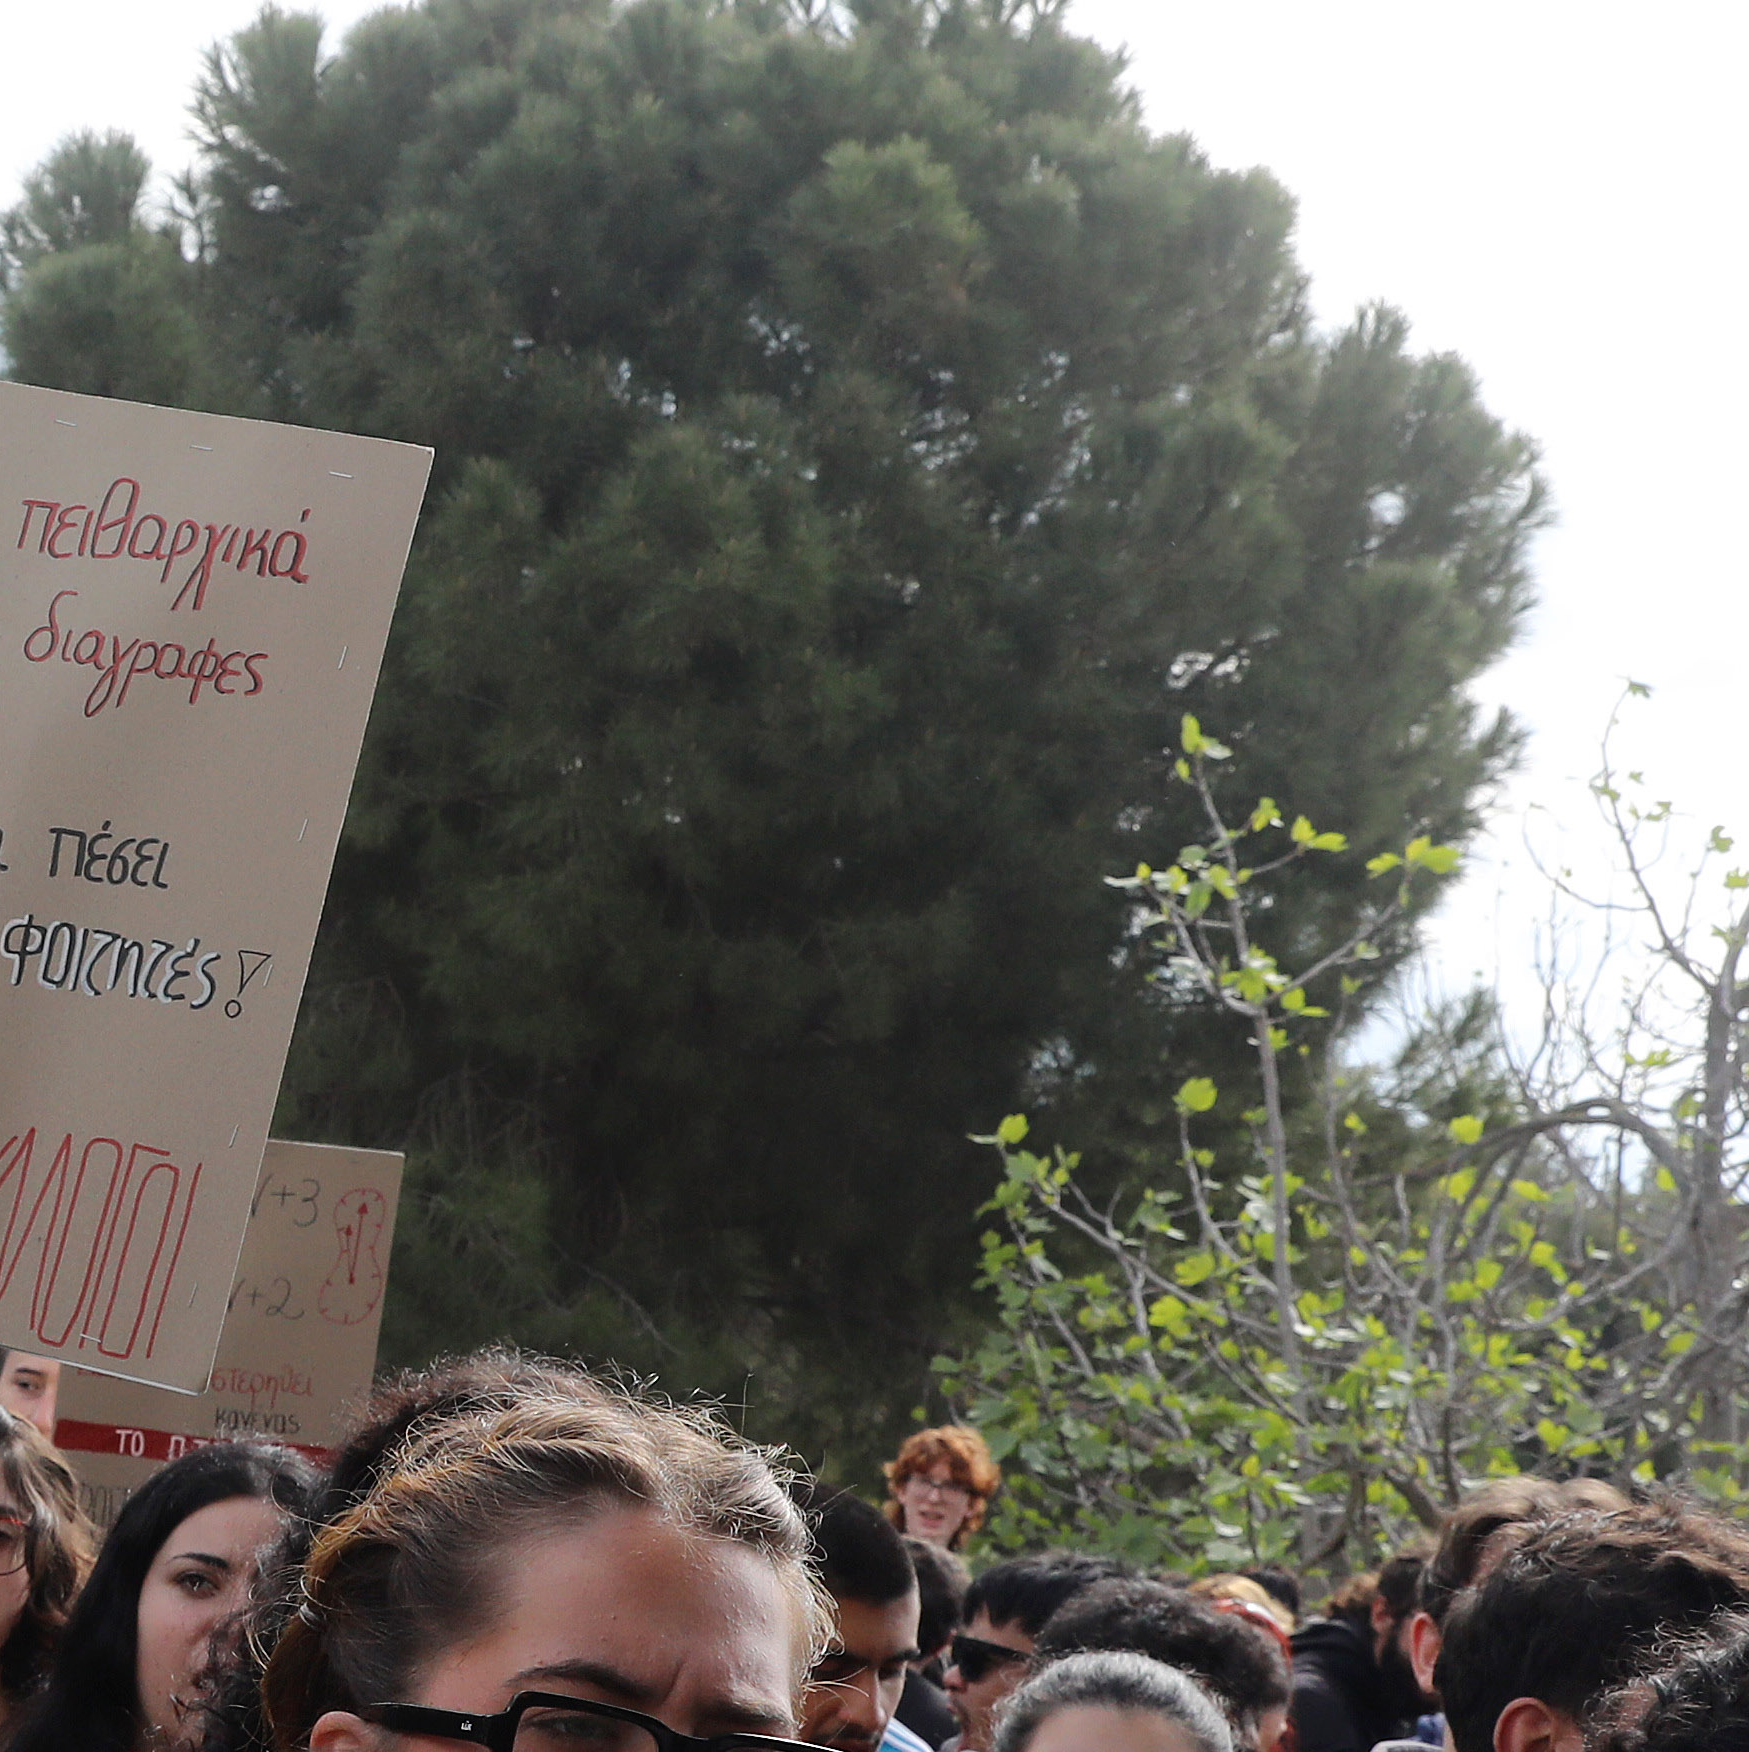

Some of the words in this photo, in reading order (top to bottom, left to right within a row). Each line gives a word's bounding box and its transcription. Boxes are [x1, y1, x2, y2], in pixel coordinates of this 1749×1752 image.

[17, 478, 312, 611] πειθαρχικά
[49, 820, 170, 890] πέσει
[115, 1429, 144, 1458] ΤΟ
